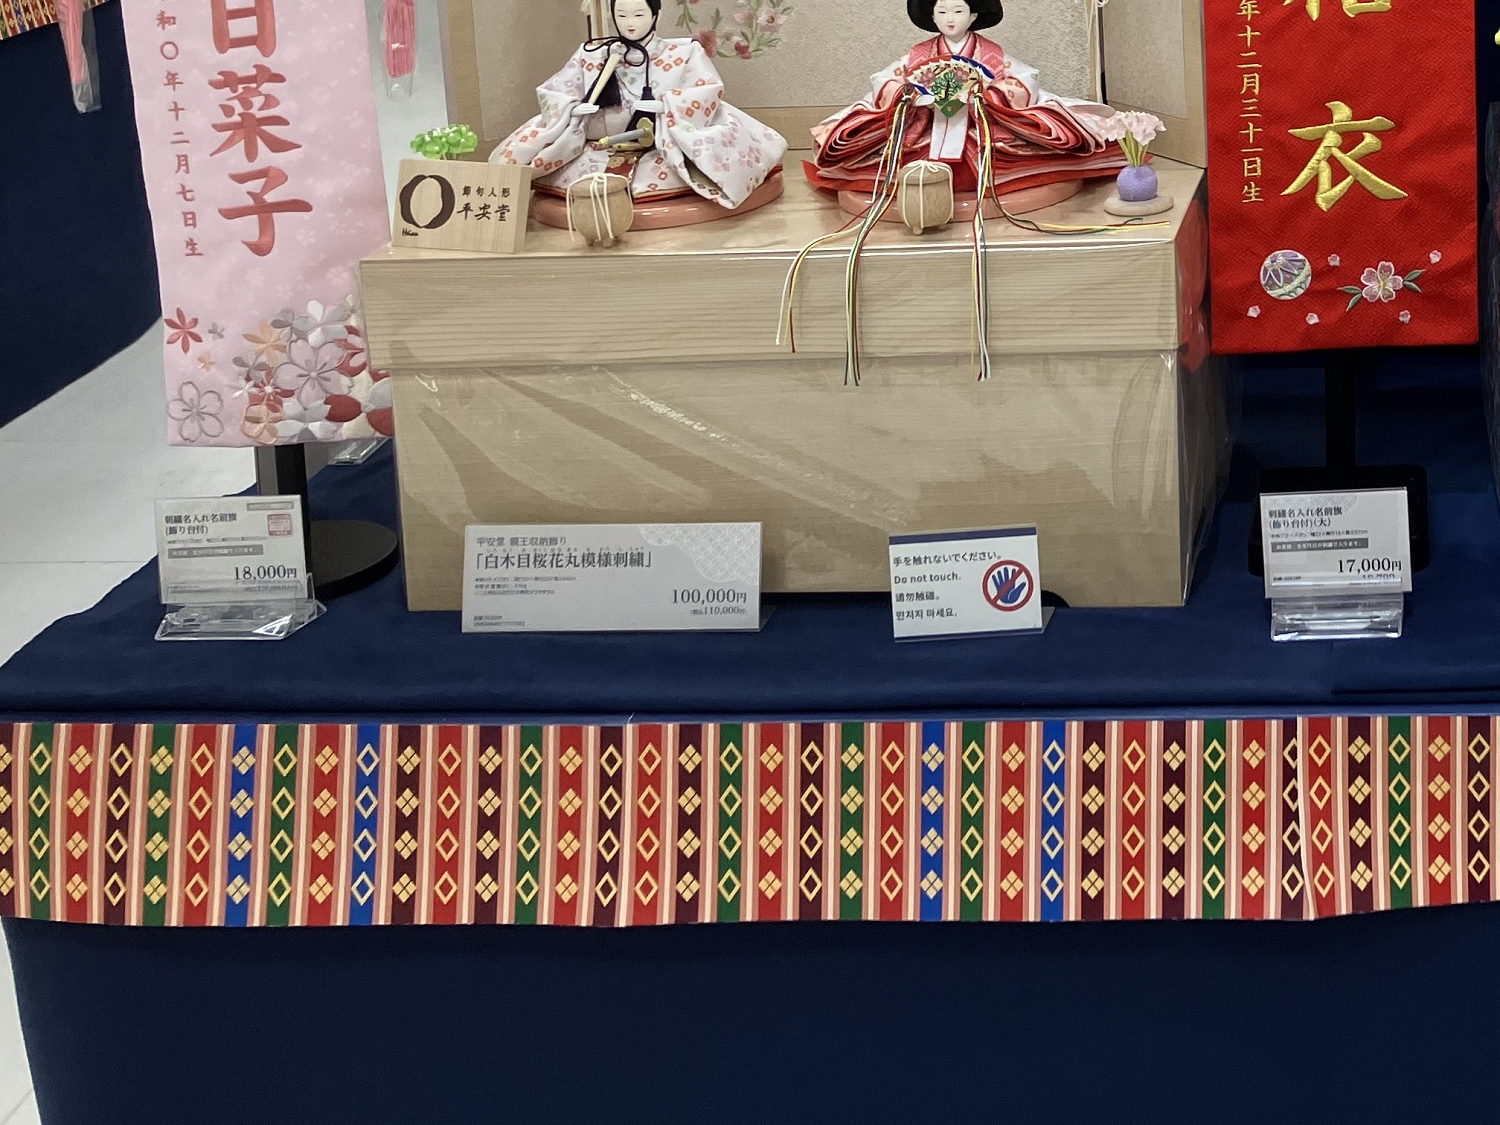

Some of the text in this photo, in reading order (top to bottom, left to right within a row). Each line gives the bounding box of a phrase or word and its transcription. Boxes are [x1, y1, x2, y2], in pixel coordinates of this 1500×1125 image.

[461, 185, 511, 198] 節句人形
[456, 202, 511, 222] 平安堂
[1268, 506, 1343, 519] 刺繍名入れ名前旗
[165, 525, 209, 536] (飾り台付)
[475, 550, 652, 570] 「白木目桜花丸模様刺繍」
[892, 550, 1002, 568] 手を触れないでください。
[1338, 557, 1402, 574] 17,000円
[234, 565, 298, 581] 18,000円
[894, 571, 962, 585] Do not touch.
[671, 588, 748, 605] 100,000円
